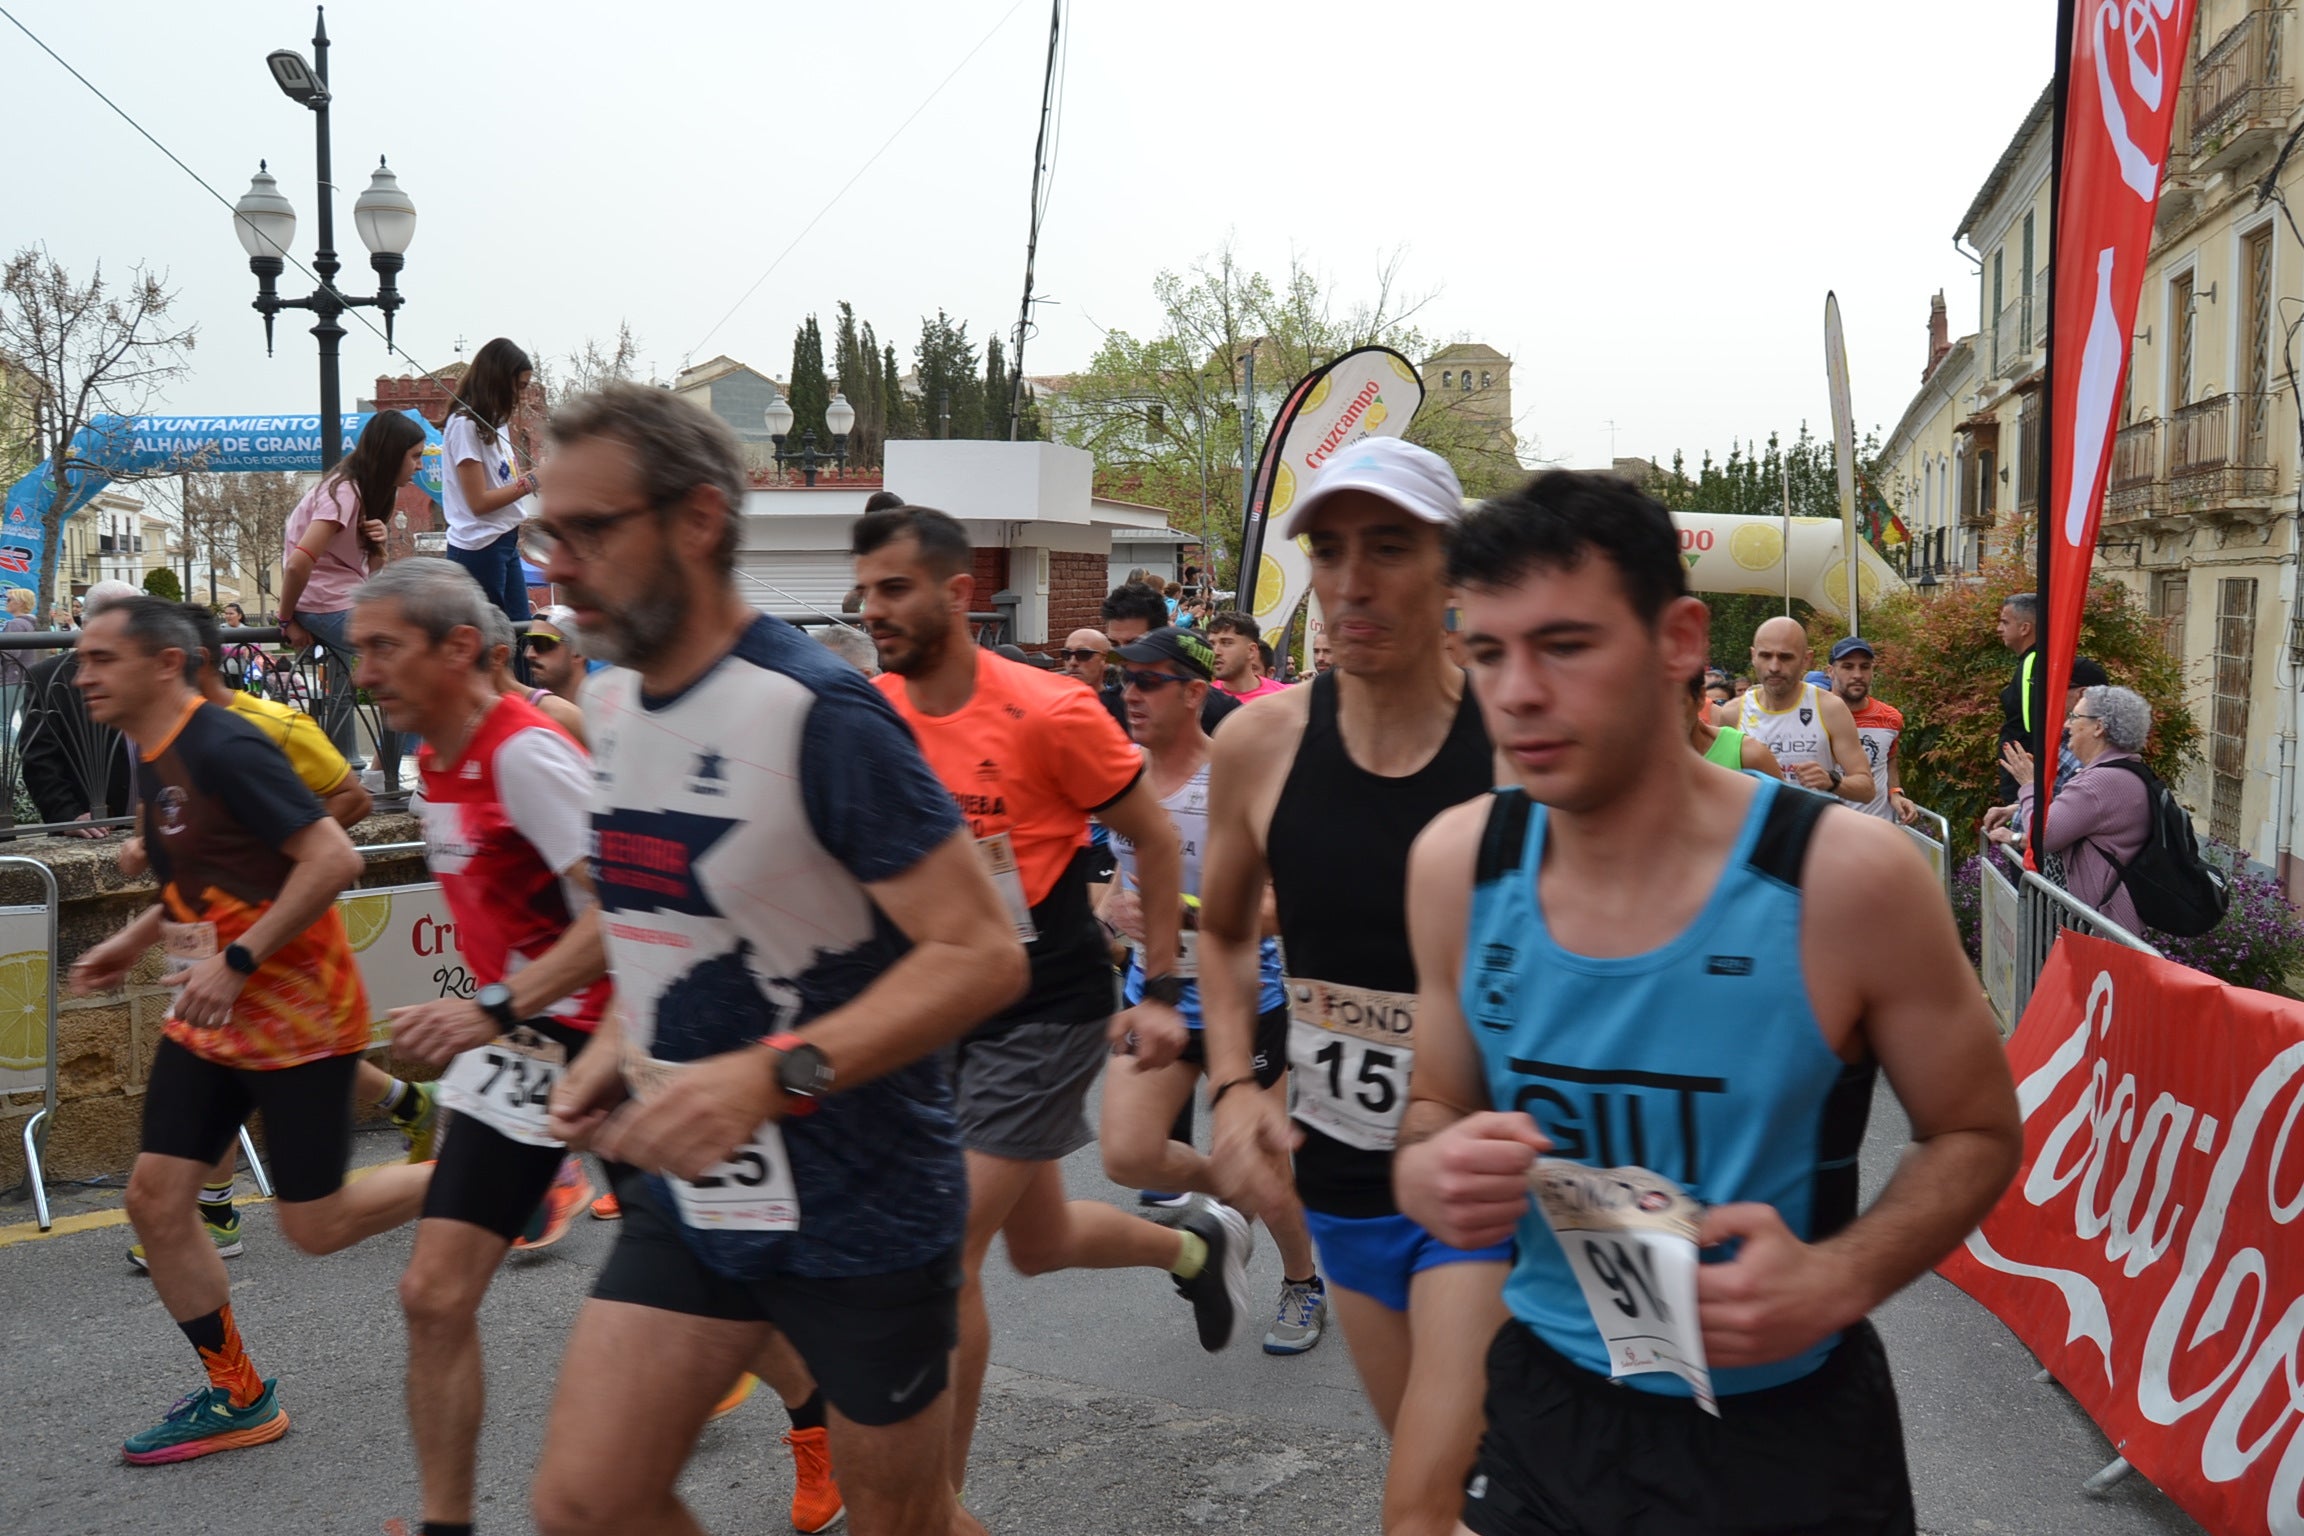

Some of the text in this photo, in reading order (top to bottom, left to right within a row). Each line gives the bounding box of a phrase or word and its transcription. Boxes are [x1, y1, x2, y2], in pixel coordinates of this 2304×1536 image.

[133, 417, 320, 432] AYUNTAMIENTO
[1305, 380, 1380, 469] Cruzcampo
[223, 437, 250, 451] DE
[255, 435, 357, 451] GRANAA
[243, 456, 260, 465] DE
[1315, 1041, 1412, 1113] 15
